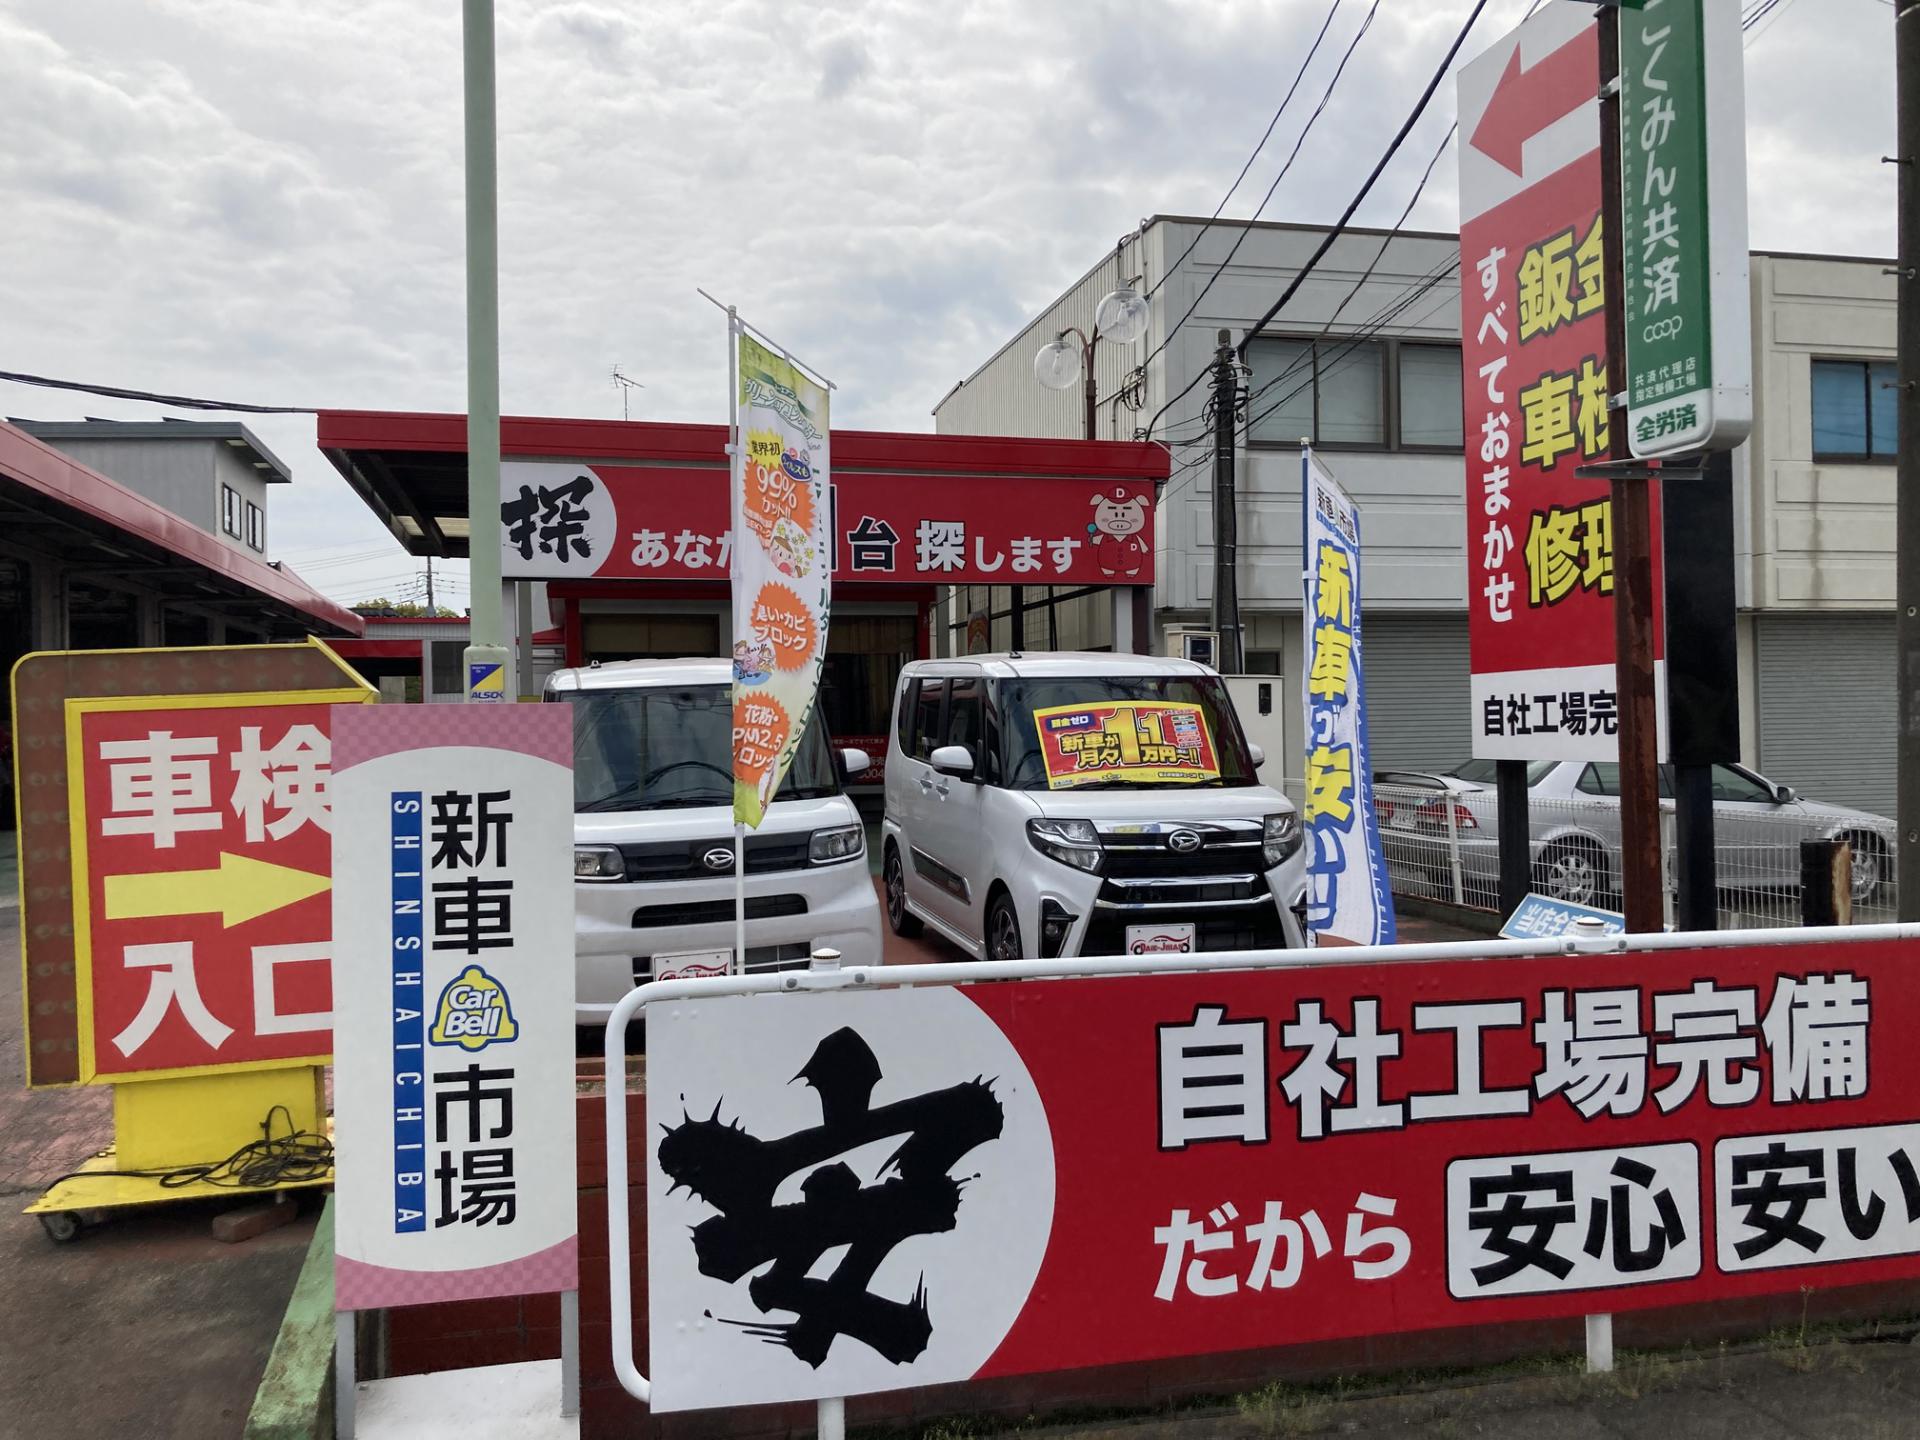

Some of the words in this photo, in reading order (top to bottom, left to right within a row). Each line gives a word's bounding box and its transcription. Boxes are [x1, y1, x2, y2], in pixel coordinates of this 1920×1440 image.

[1635, 356, 1696, 388] 共済代理店
[1476, 246, 1514, 623] すべておまかせ
[1635, 403, 1697, 443] 全労済
[756, 464, 797, 509] 99%
[1115, 487, 1125, 498] D
[500, 475, 594, 562] 探
[1130, 543, 1138, 551] D
[754, 625, 808, 651] ブロック
[732, 727, 784, 751] PM2.5
[733, 746, 776, 772] ロック
[99, 724, 333, 848] 車検
[430, 790, 515, 956] 新車
[112, 939, 333, 1059] 入口
[446, 982, 498, 1015] Car
[444, 1007, 501, 1040] Bell
[1158, 972, 1869, 1150] 自社工場完備
[432, 1063, 517, 1231] 市場
[658, 1025, 1004, 1371] 安
[1153, 1192, 1412, 1302] だから
[1468, 1156, 1686, 1287] 安心
[1730, 1141, 1920, 1262] 安い
